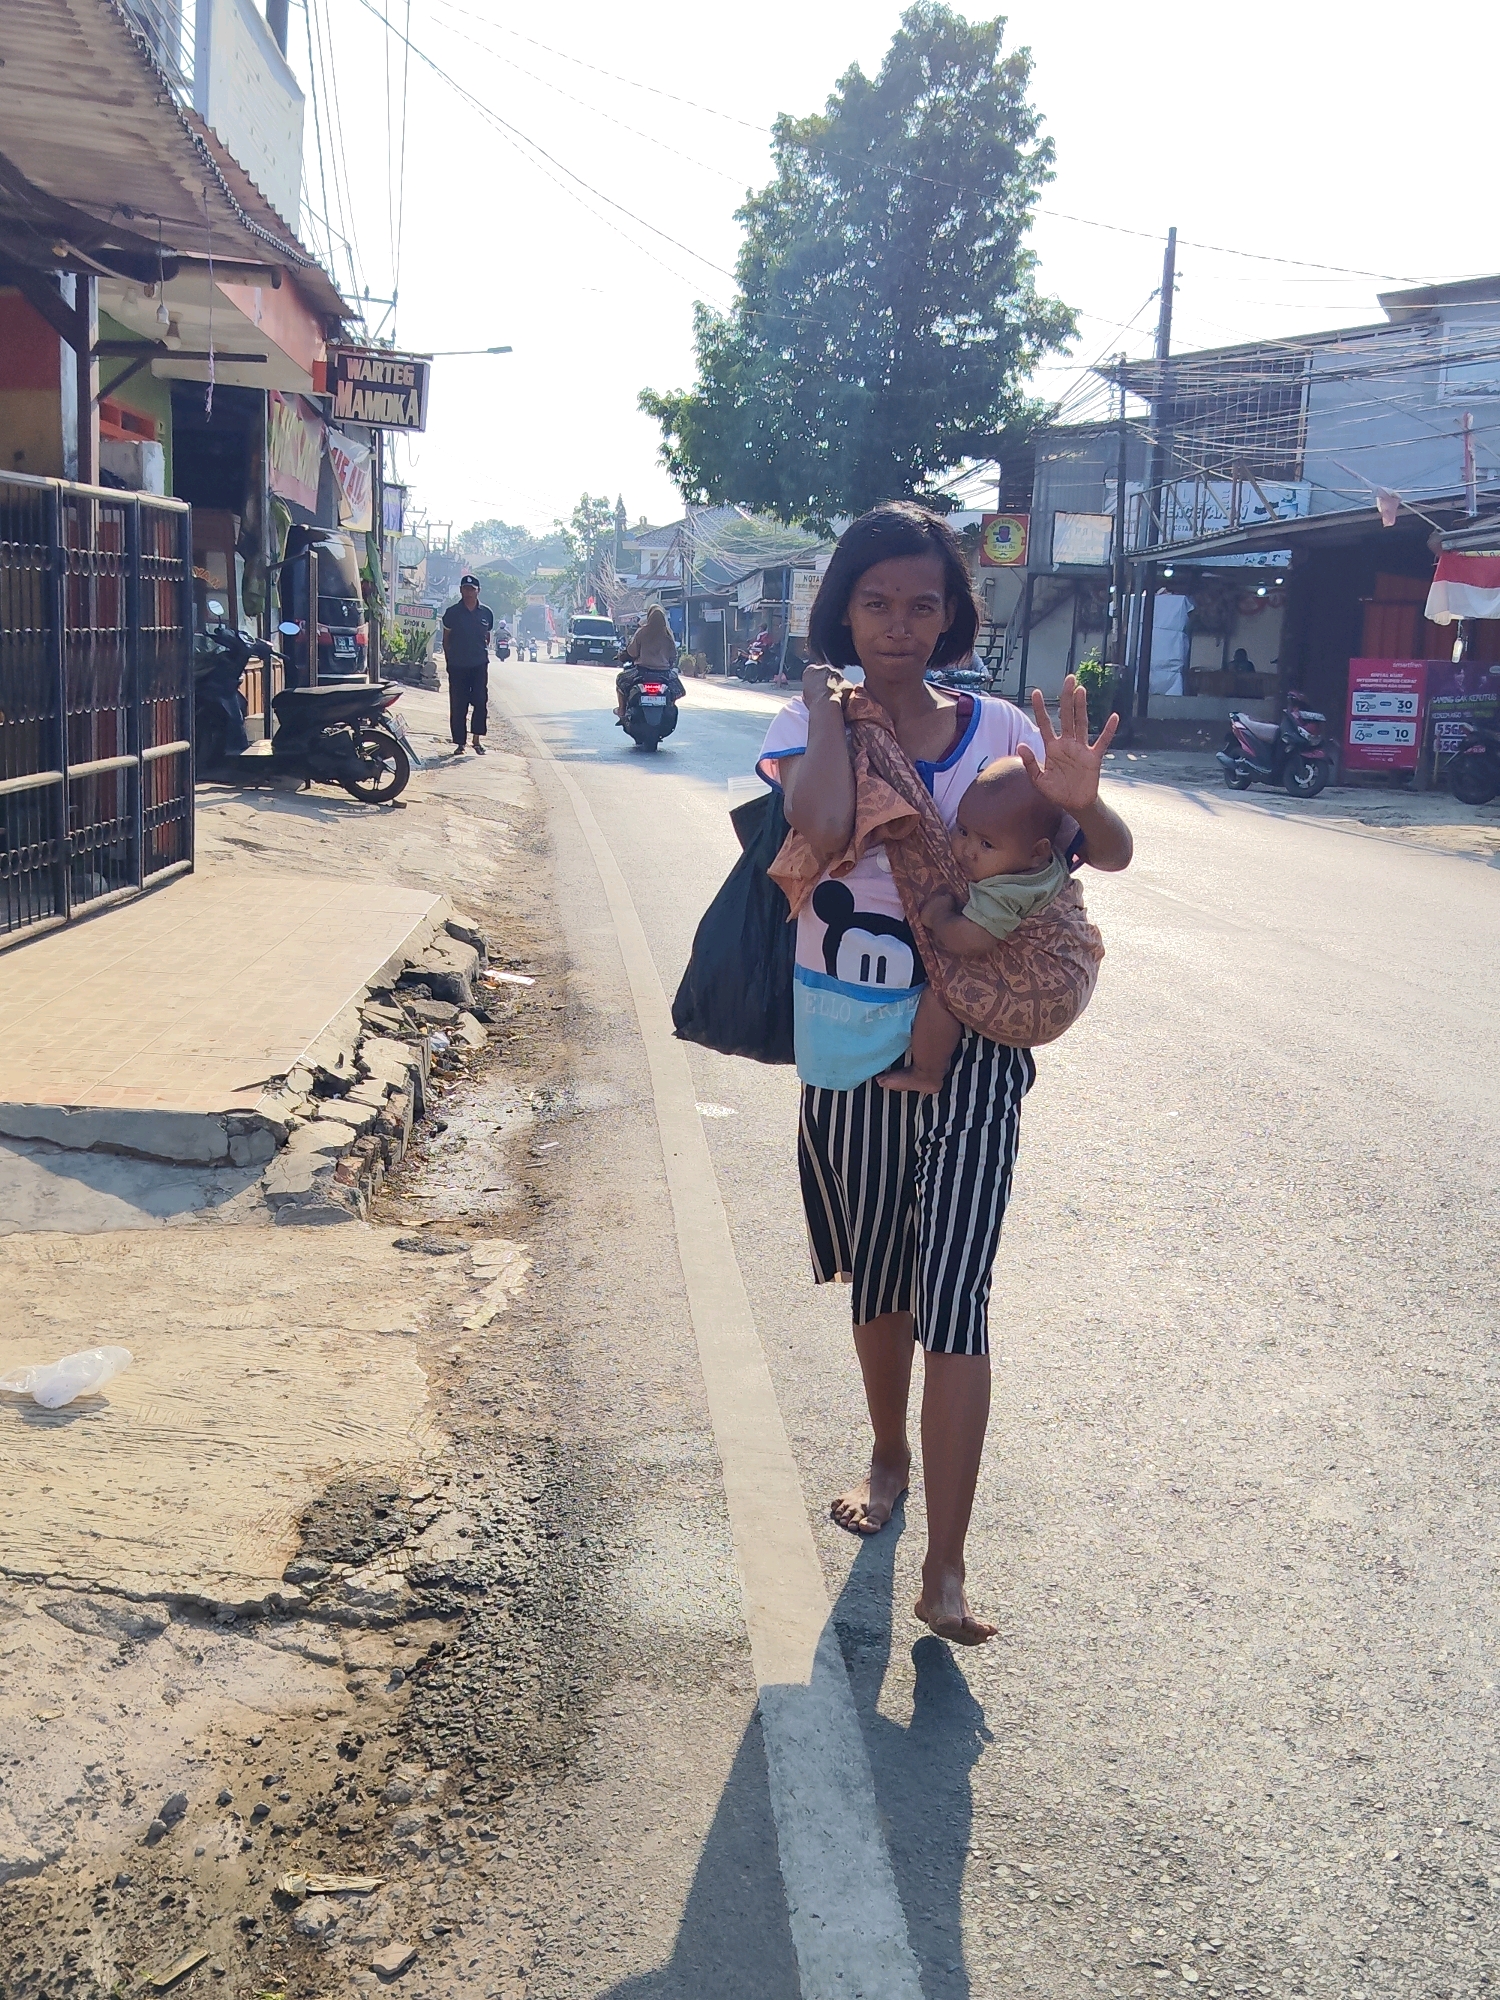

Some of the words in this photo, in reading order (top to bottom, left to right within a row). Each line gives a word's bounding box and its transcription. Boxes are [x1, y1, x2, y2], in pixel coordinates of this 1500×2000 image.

[346, 358, 415, 387] WARTEG
[334, 380, 420, 426] MAMOKA
[1397, 700, 1413, 709] 30
[1395, 729, 1409, 738] 10
